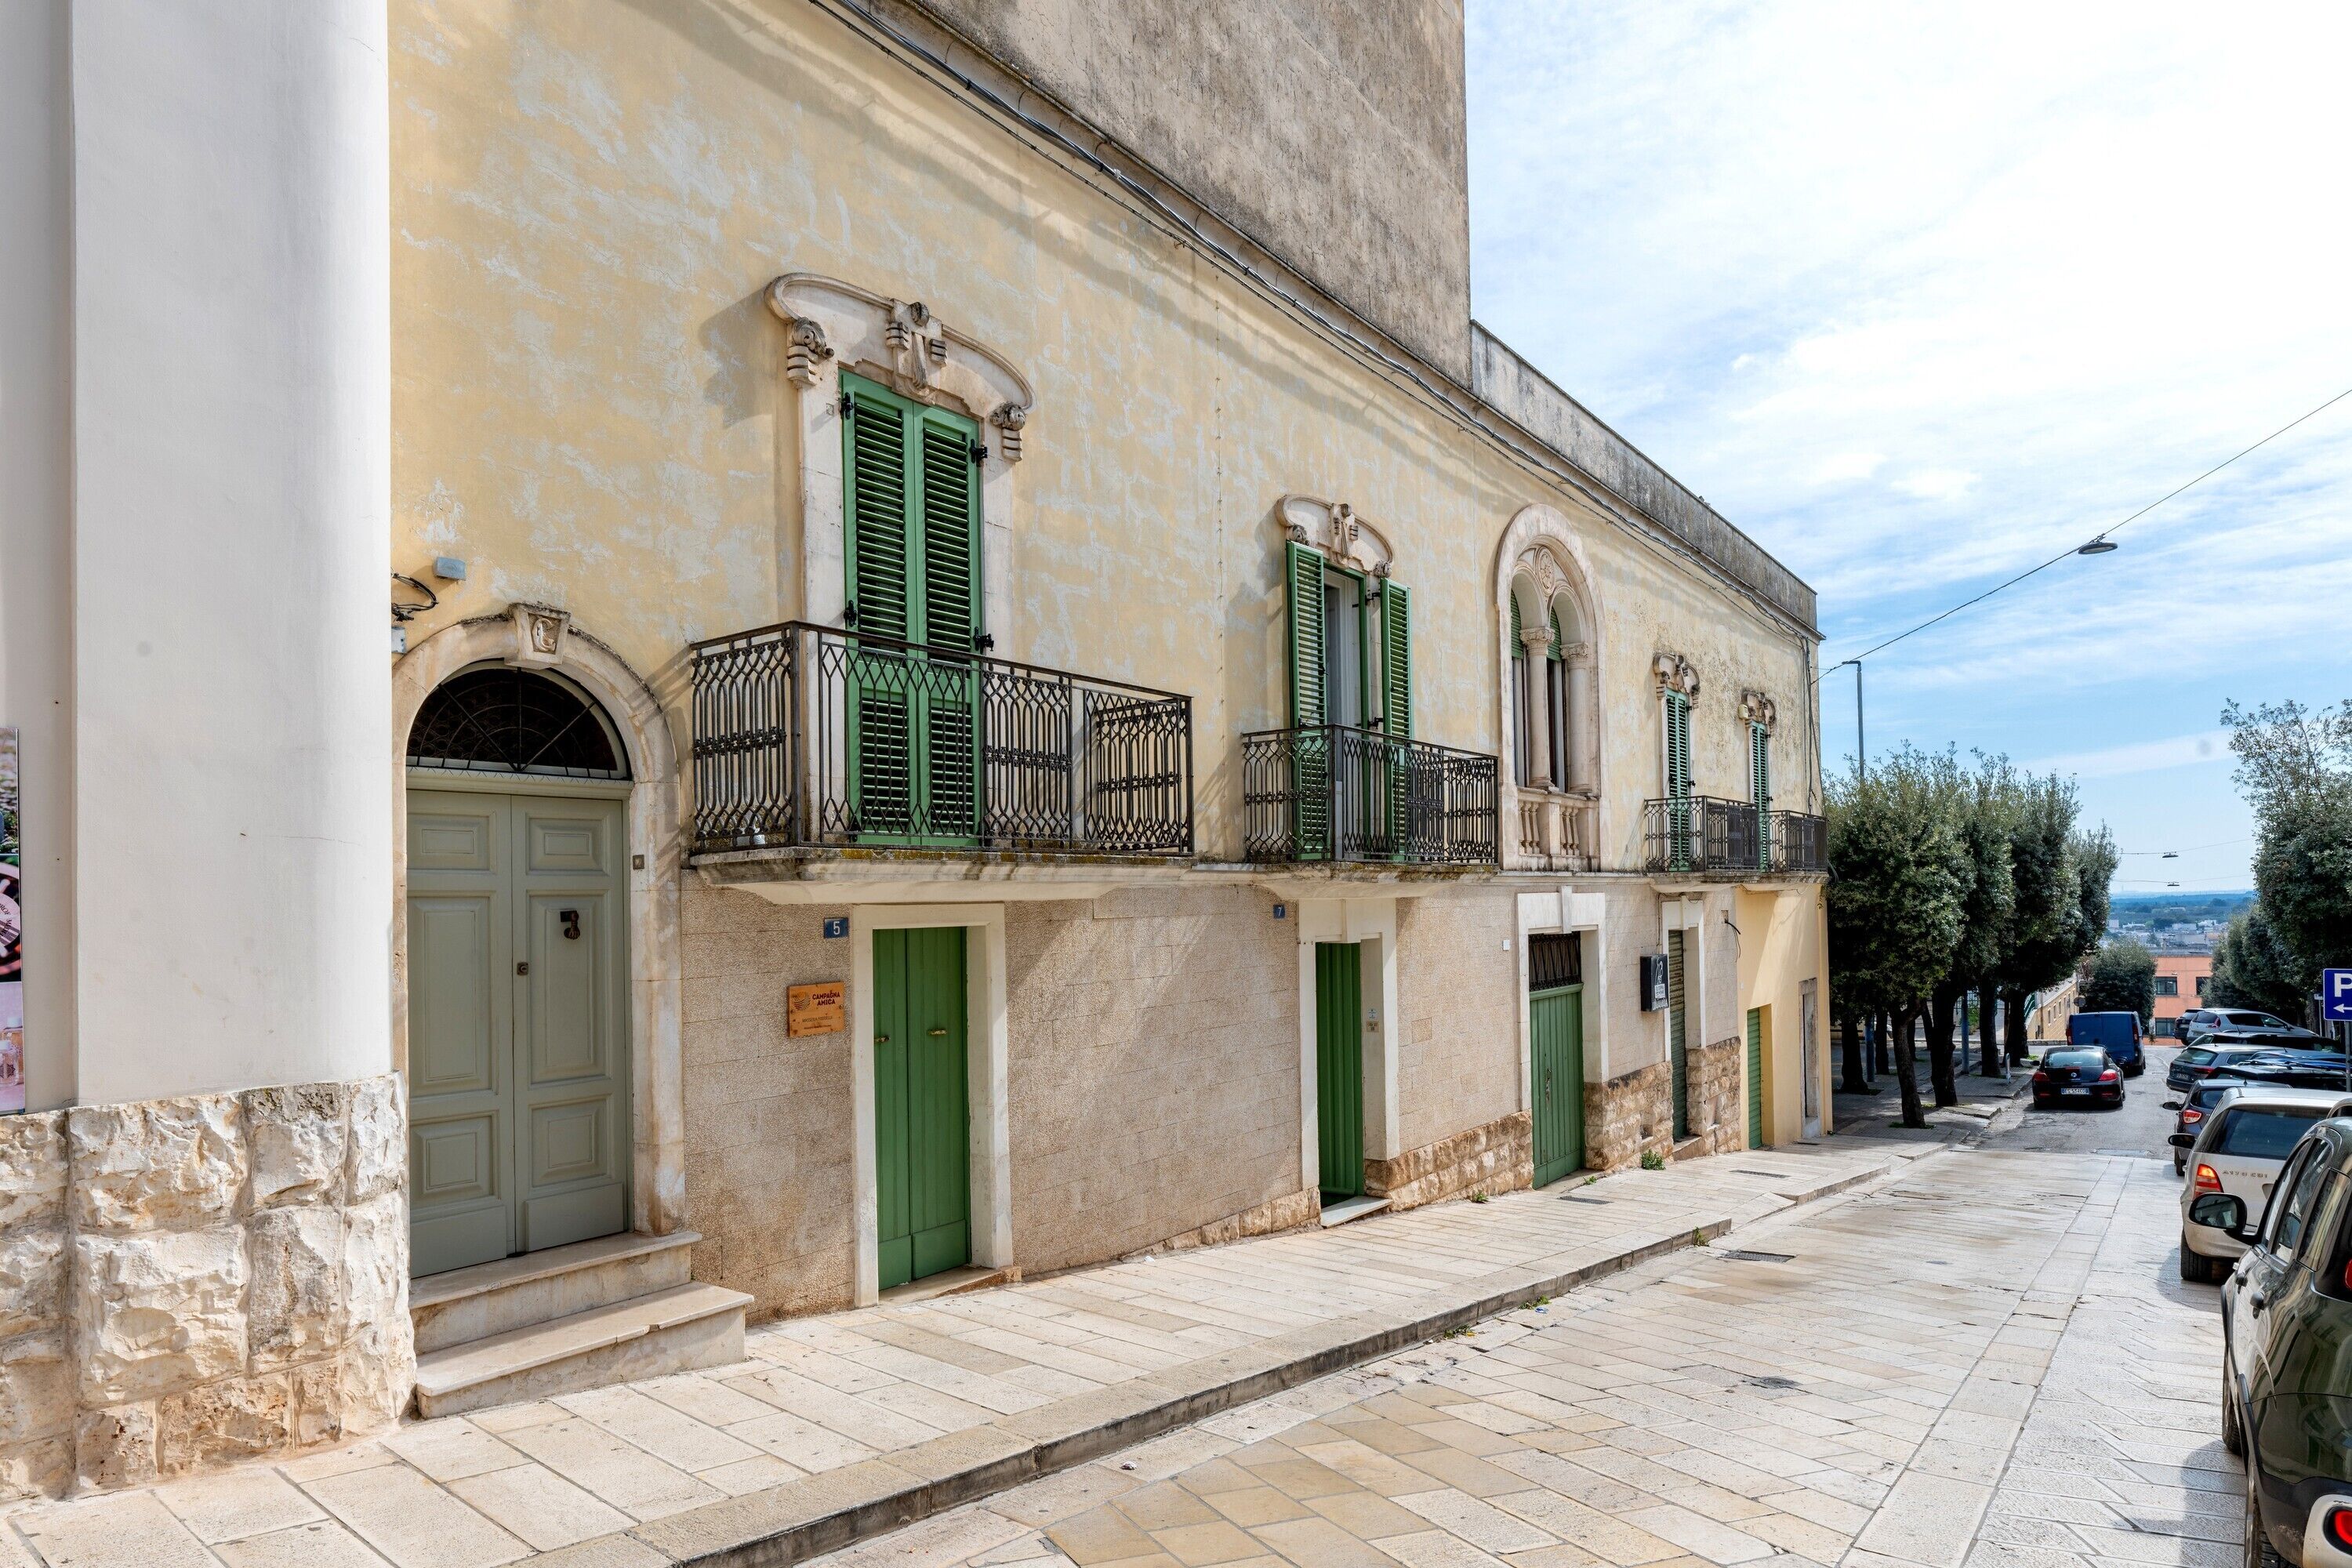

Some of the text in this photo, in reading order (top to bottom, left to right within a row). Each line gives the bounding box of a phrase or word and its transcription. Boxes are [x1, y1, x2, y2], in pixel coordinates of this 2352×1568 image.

[1278, 907, 1282, 916] 7
[833, 920, 840, 935] 5
[2334, 973, 2352, 997] P
[812, 991, 840, 1000] CAMPAGNA
